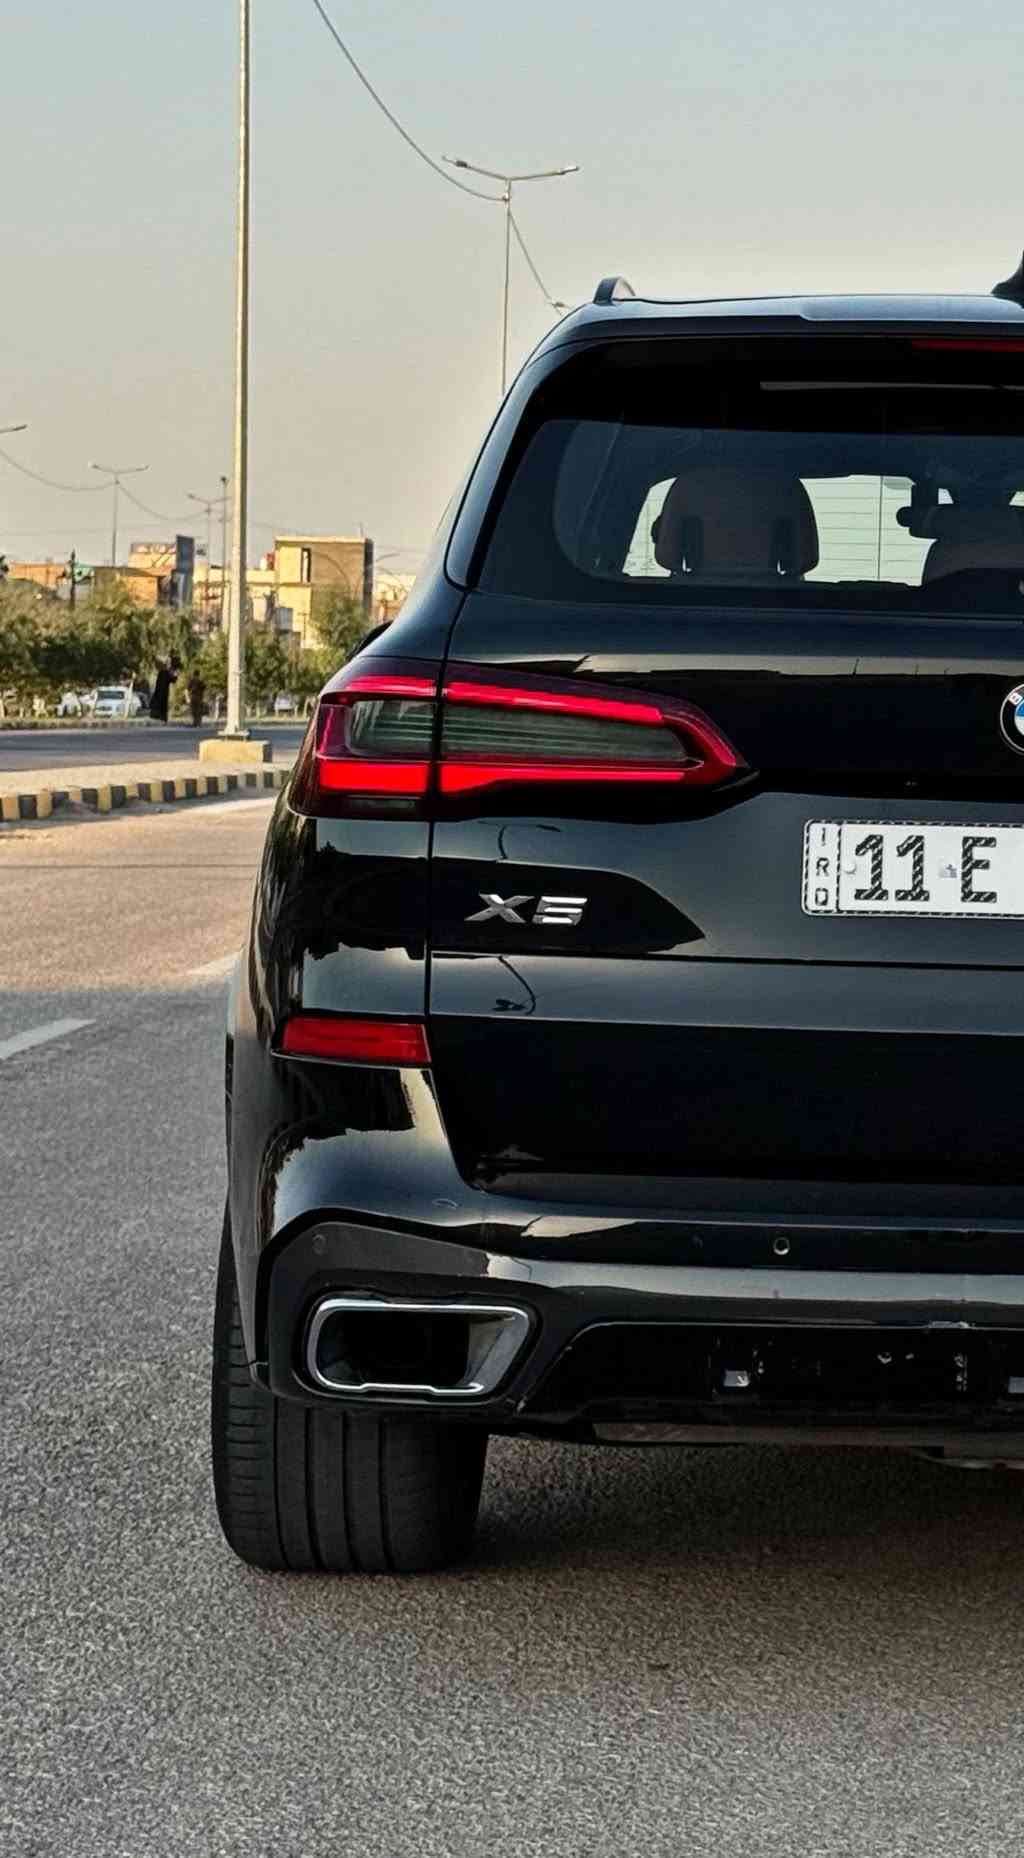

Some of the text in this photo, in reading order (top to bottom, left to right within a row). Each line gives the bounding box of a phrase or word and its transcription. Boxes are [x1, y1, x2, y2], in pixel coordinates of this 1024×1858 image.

[854, 834, 997, 903] 11 E
[463, 890, 588, 926] X5
